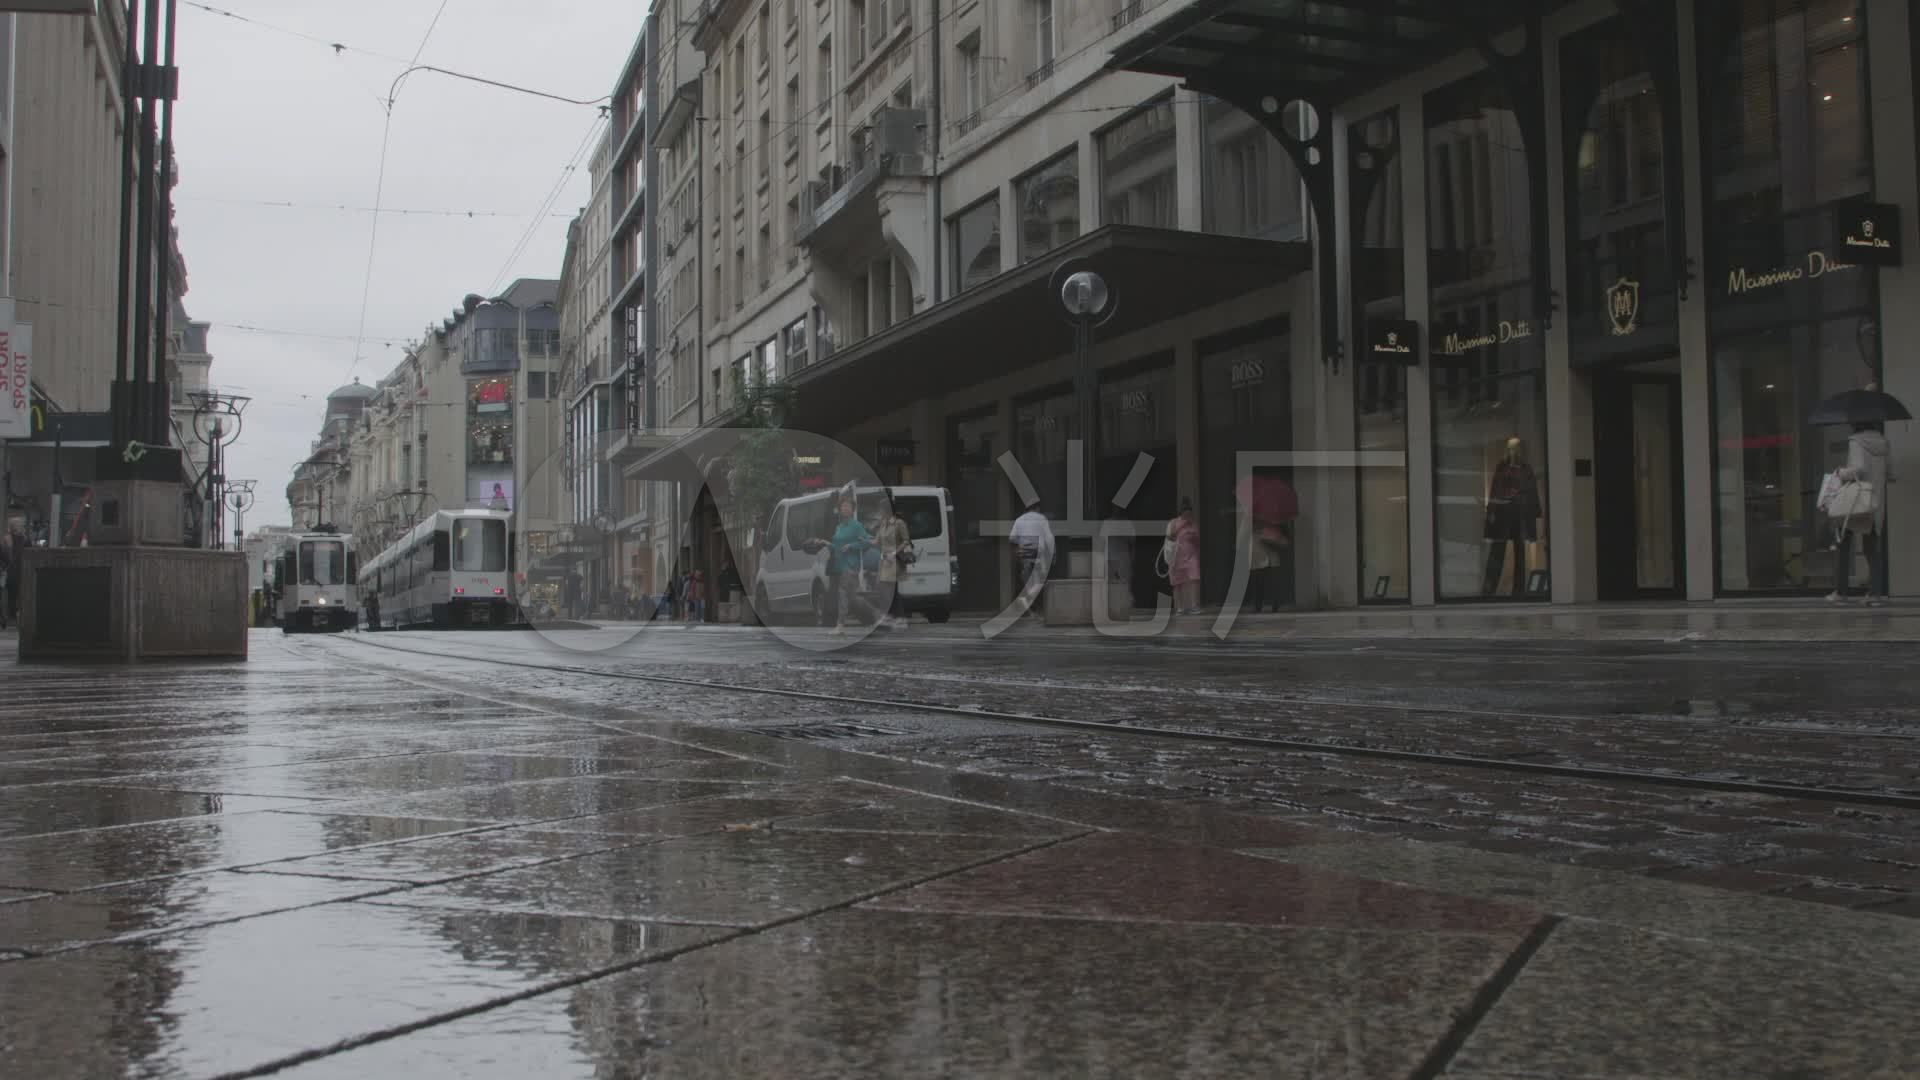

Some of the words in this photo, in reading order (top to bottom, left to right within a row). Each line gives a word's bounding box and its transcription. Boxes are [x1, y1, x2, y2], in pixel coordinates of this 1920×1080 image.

[1727, 266, 1802, 296] Massimo
[1445, 331, 1497, 354] Massimo
[1498, 319, 1532, 344] Dutti
[13, 351, 27, 409] SPORT
[1231, 360, 1264, 383] BOSS
